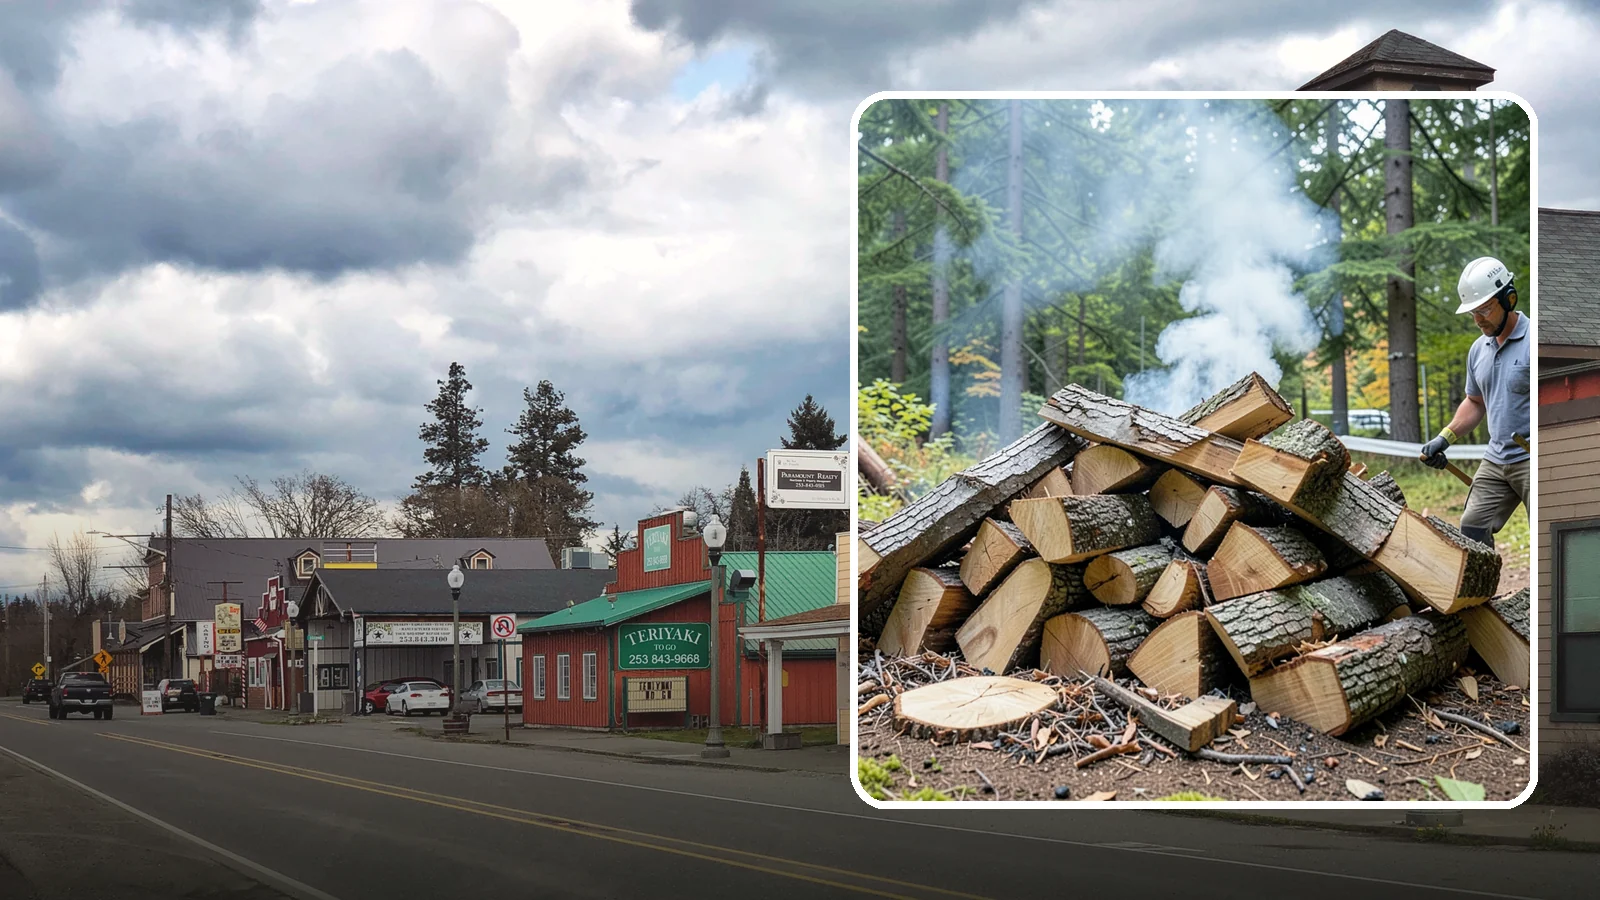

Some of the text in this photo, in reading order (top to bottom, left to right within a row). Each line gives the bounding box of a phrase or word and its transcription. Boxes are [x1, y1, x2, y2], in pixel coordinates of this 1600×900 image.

[781, 471, 839, 480] PARAMOUNT REALTY
[624, 627, 702, 646] TERIYAKI
[629, 654, 700, 665] 253 843-9668
[639, 681, 673, 691] TERIYAKI
